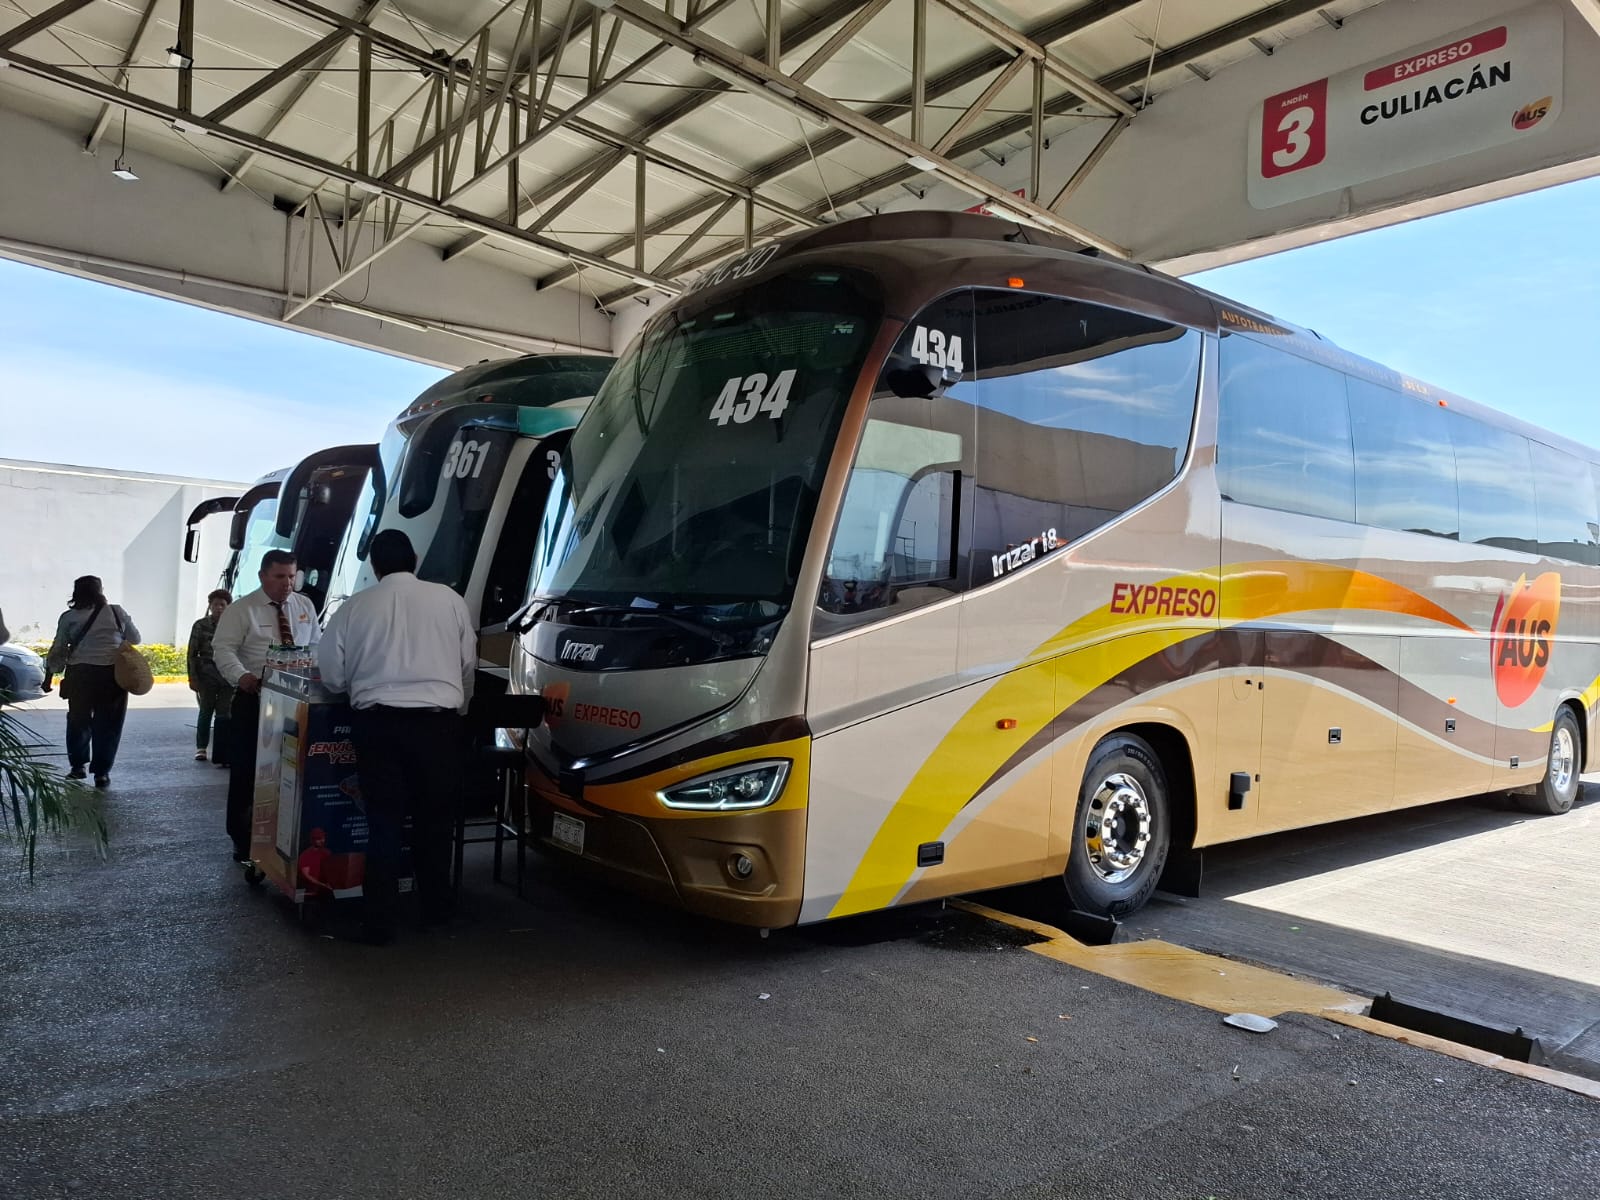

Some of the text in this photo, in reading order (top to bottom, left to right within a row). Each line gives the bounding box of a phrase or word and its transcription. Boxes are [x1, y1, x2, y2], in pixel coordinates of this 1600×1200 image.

[1394, 42, 1473, 79] EXPRESO
[1281, 93, 1309, 107] ANDÉN
[1360, 61, 1511, 125] CULIACÁN
[1515, 106, 1547, 122] AUS
[1272, 106, 1315, 168] 3
[911, 325, 964, 373] 434
[708, 369, 798, 426] 434
[443, 440, 492, 479] 361
[992, 527, 1058, 578] Irizar i8
[1110, 583, 1217, 617] EXPRESO
[560, 639, 604, 662] Irizar
[1498, 618, 1551, 668] AUS
[574, 703, 641, 730] EXPRESO
